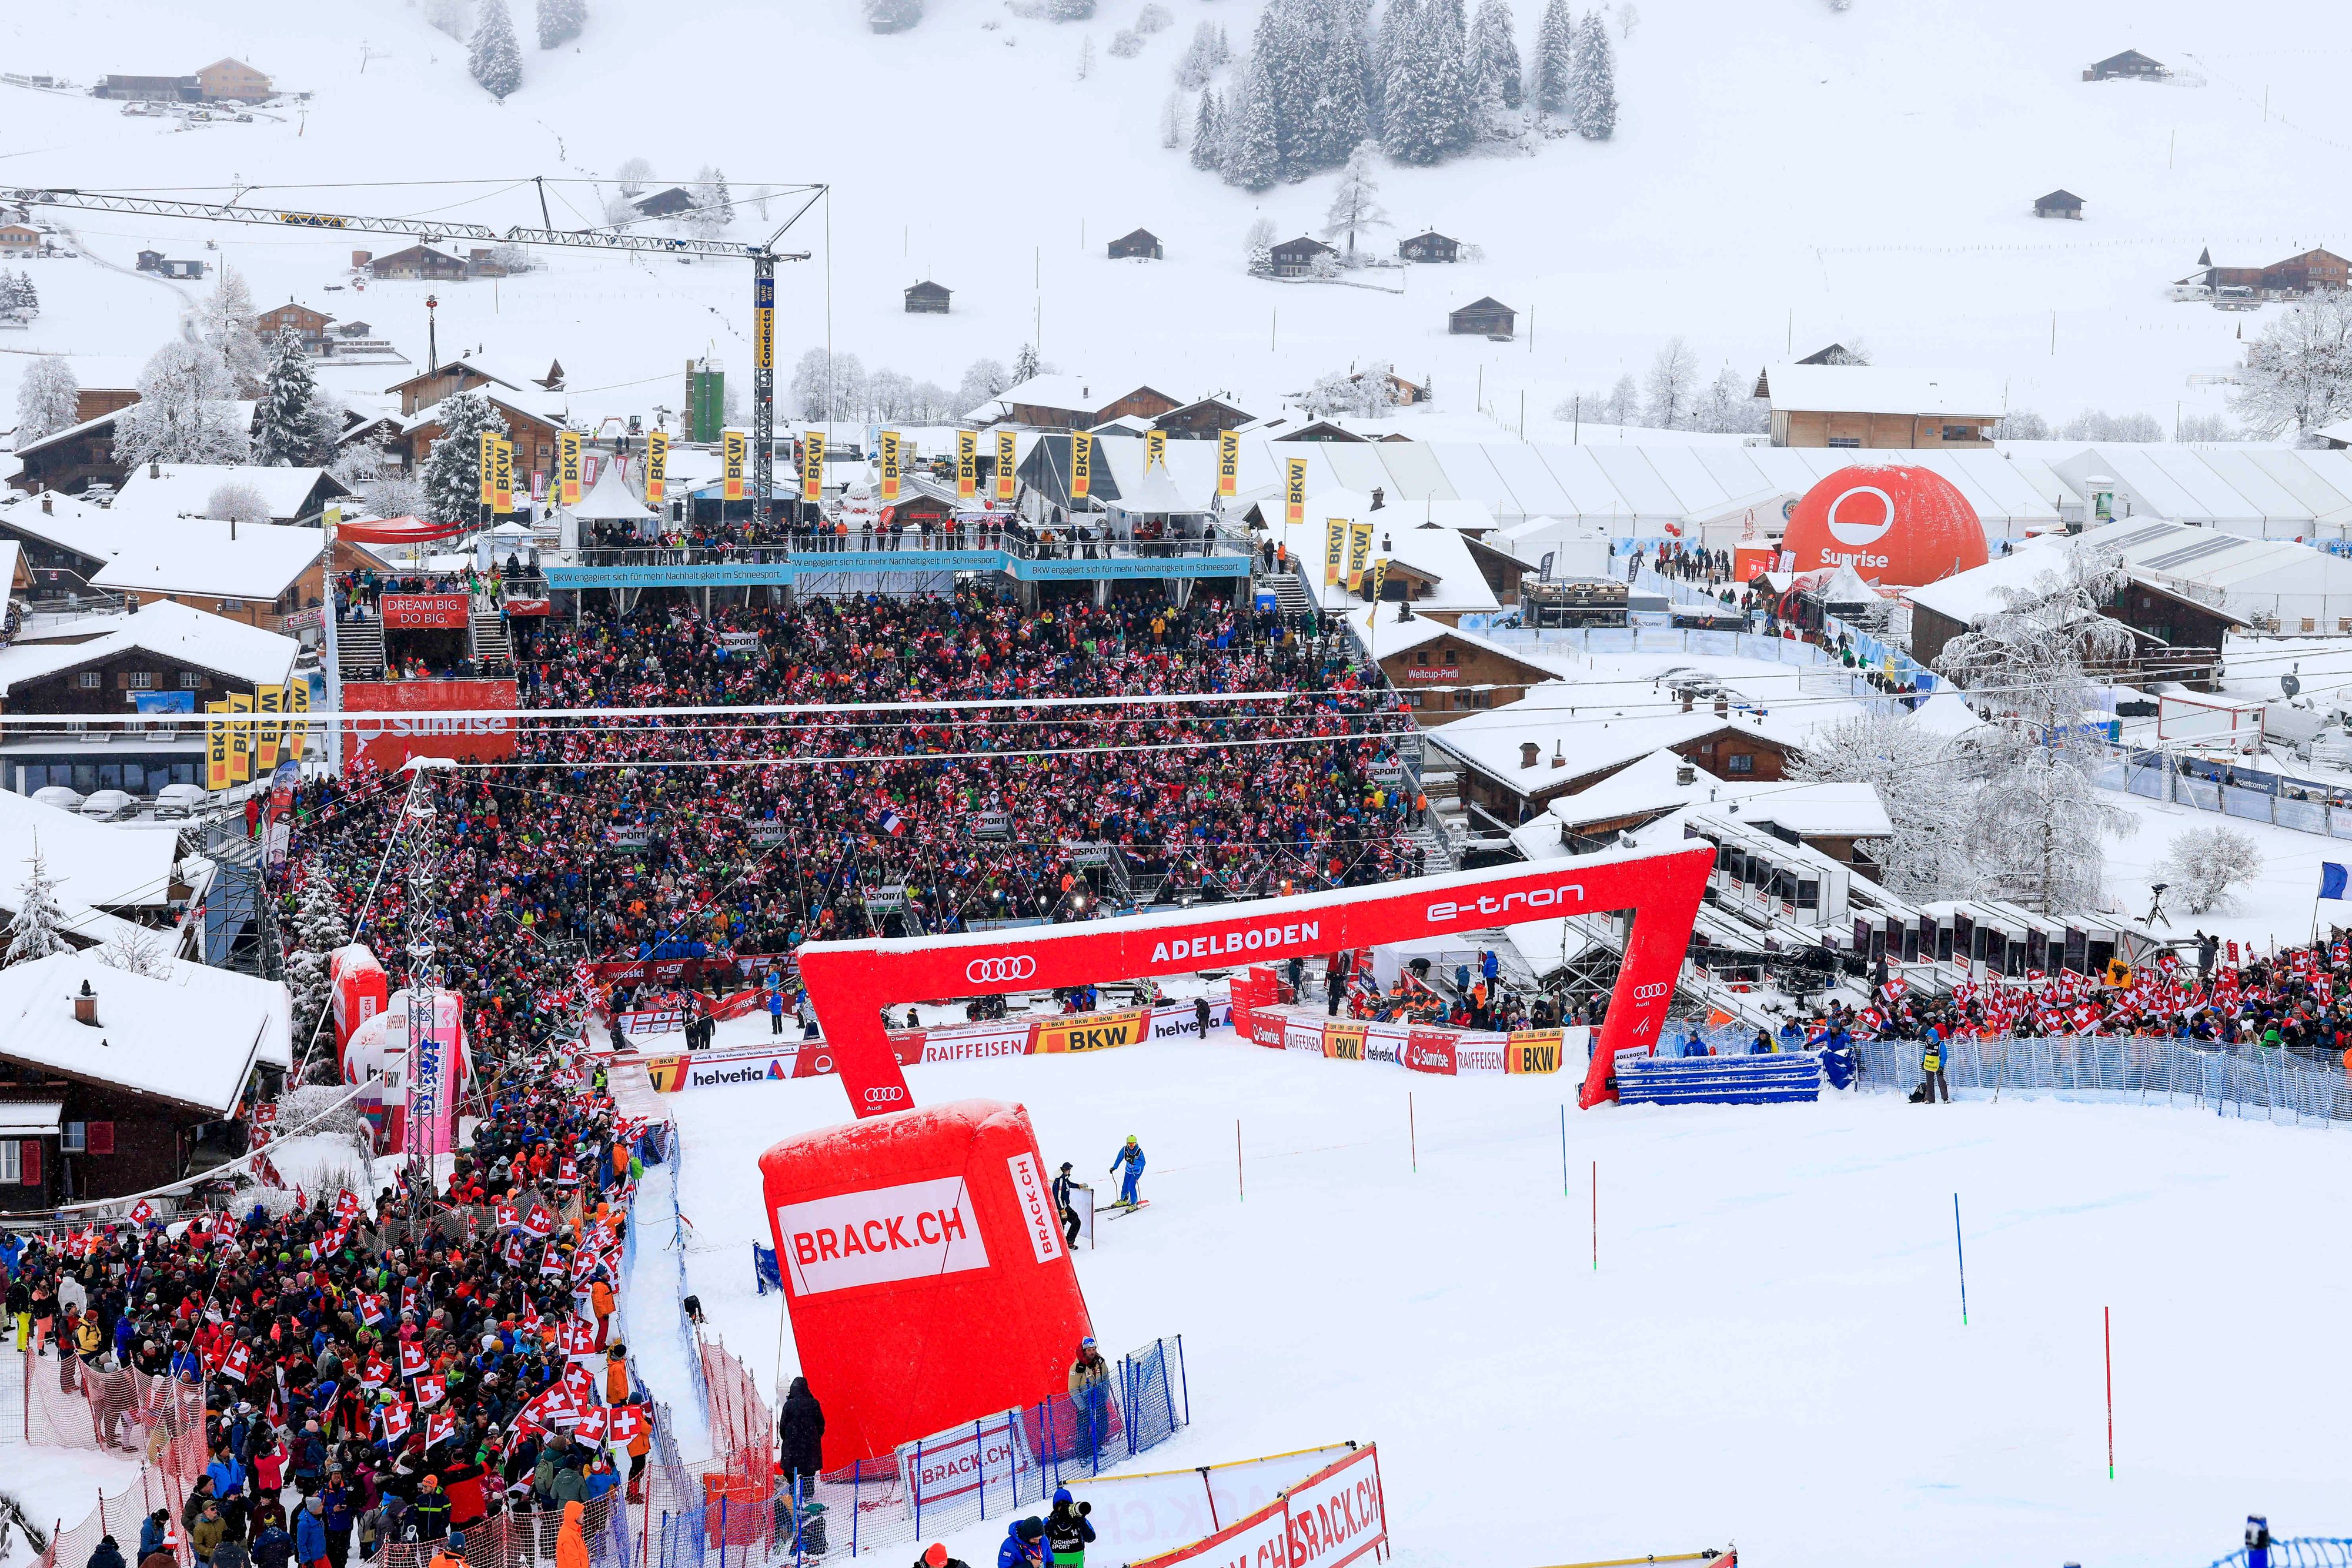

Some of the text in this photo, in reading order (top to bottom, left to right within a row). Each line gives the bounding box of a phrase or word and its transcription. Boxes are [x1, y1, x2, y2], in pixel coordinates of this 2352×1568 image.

[762, 309, 770, 367] Condecta
[564, 439, 577, 480] BKW
[651, 438, 665, 480] BKW
[728, 437, 741, 478] BKW
[808, 437, 821, 479] BKW
[885, 437, 896, 477] BKW
[961, 437, 974, 477] BKW
[1000, 437, 1013, 477] BKW
[1076, 437, 1088, 477] BKW
[1150, 436, 1163, 464] KW
[1221, 436, 1236, 474] BKW
[497, 447, 509, 490] BKW
[1291, 464, 1304, 503] BKW
[1329, 526, 1344, 564] BKW
[1353, 530, 1367, 570] BKW
[804, 559, 837, 568] engagiert
[889, 557, 940, 566] Nachhaltigkeit
[953, 556, 998, 566] Schneesport.
[1051, 566, 1084, 575] engagiert
[1135, 564, 1184, 574] Nachhaltigkeit
[1196, 563, 1240, 572] Schneesport.
[1541, 556, 1551, 581] GRILL-BBQ
[1629, 556, 1639, 581] GRILL-BBQ
[1820, 548, 1889, 568] Sunrise
[574, 573, 611, 583] engagiert
[613, 572, 628, 581] sich
[630, 572, 642, 580] für
[666, 571, 720, 581] Nachhaltigkeit
[734, 570, 782, 580] Schneesport.
[388, 600, 461, 610] DREAM BIG.
[401, 613, 448, 623] DO BIG.
[1408, 669, 1459, 680] Weltcup-Pintli
[984, 817, 1005, 825] PORT
[1079, 847, 1108, 855] SPORT
[870, 892, 900, 901] SPORT
[1426, 884, 1584, 922] e-tron
[1151, 921, 1319, 963] ADELBODEN
[1070, 1026, 1127, 1051] BKW
[1259, 1027, 1280, 1045] Sunrise
[1285, 1032, 1322, 1052] RAIFFEISEN
[1336, 1038, 1358, 1059] BKW
[927, 1039, 1021, 1062] RAIFFEISEN
[1367, 1044, 1394, 1062] helvetia
[1421, 1047, 1449, 1067] Sunrise
[1458, 1051, 1503, 1069] RAIFFEISEN
[1524, 1046, 1553, 1071] BKW
[1616, 1050, 1647, 1060] ADELBODEN
[387, 1071, 400, 1088] BKW
[693, 1066, 763, 1086] helvetia
[1017, 1161, 1053, 1254] BRACK.CH
[794, 1207, 966, 1265] BRACK.CH
[921, 1443, 1011, 1485] BRACK.CH
[1291, 1473, 1379, 1567] BRACK.CH
